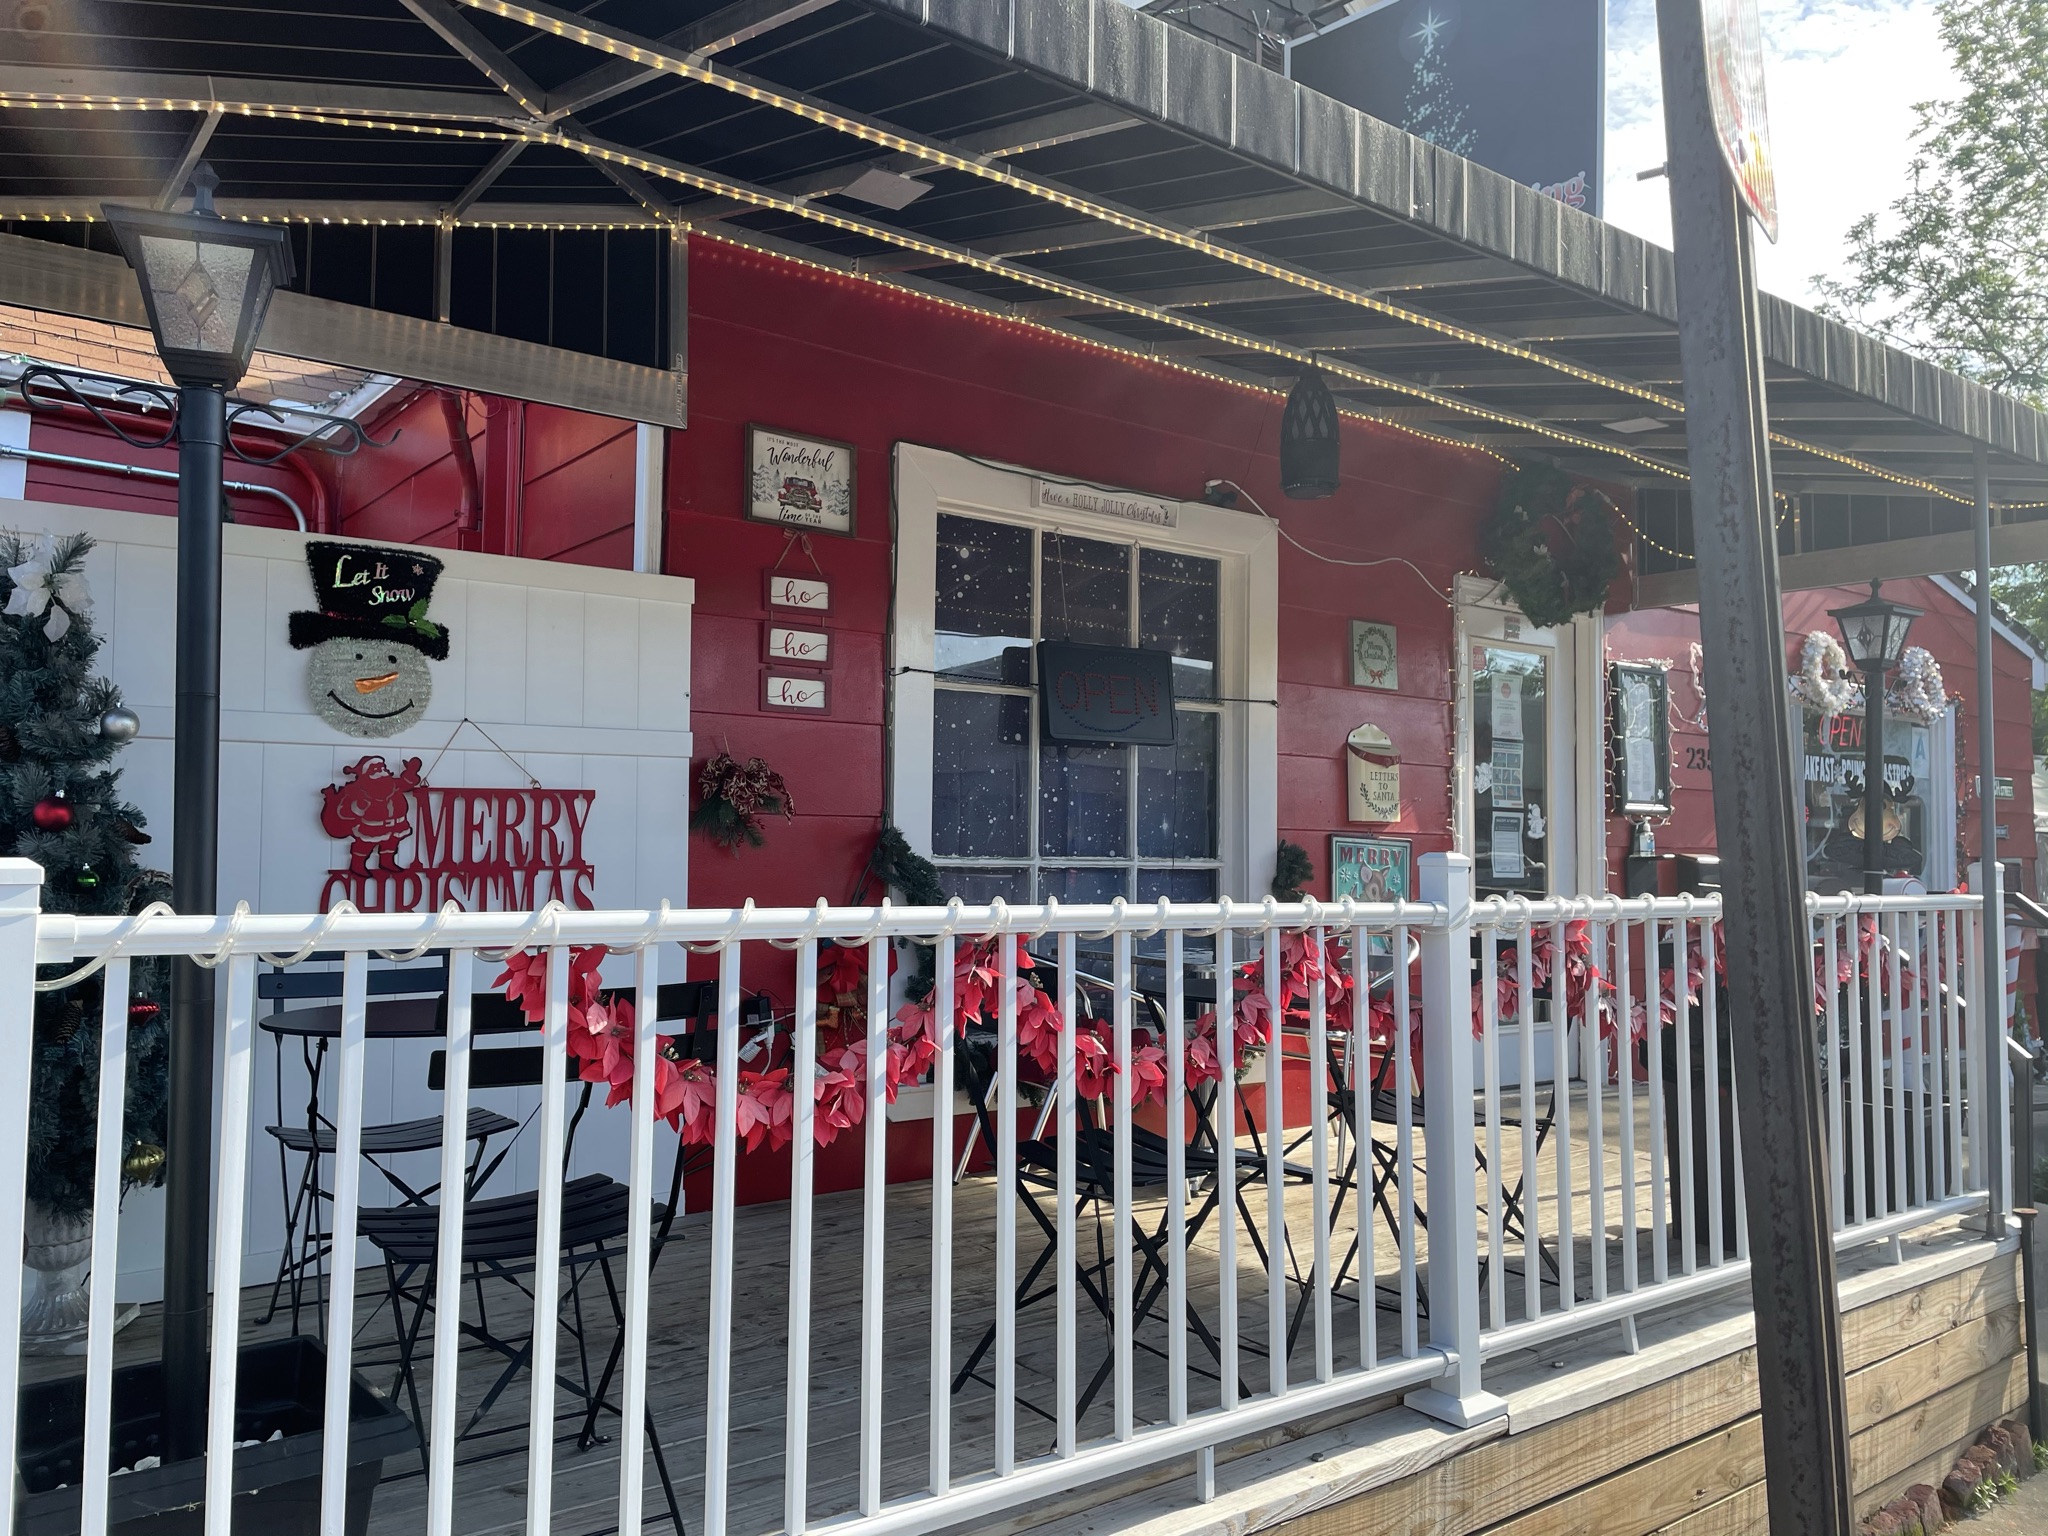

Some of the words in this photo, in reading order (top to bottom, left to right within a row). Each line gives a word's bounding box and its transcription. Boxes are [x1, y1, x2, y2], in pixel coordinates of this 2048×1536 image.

[767, 447, 835, 472] Wonderful
[778, 506, 804, 522] time
[1073, 493, 1099, 511] HOLLY
[1101, 499, 1126, 516] JOLLY
[805, 517, 822, 525] YEAR
[332, 555, 371, 588] Let
[374, 561, 390, 581] It
[368, 585, 415, 606] Snow
[778, 580, 821, 605] ho
[776, 632, 820, 656] ho
[774, 679, 817, 705] ho
[1056, 670, 1159, 717] OPEN
[1819, 715, 1863, 747] OPEN
[1915, 735, 1927, 760] A
[1370, 771, 1399, 781] LETTERS
[1378, 782, 1388, 791] TO
[1373, 791, 1395, 801] SANTA
[410, 788, 596, 869] MERRY
[1340, 846, 1403, 867] MERRY
